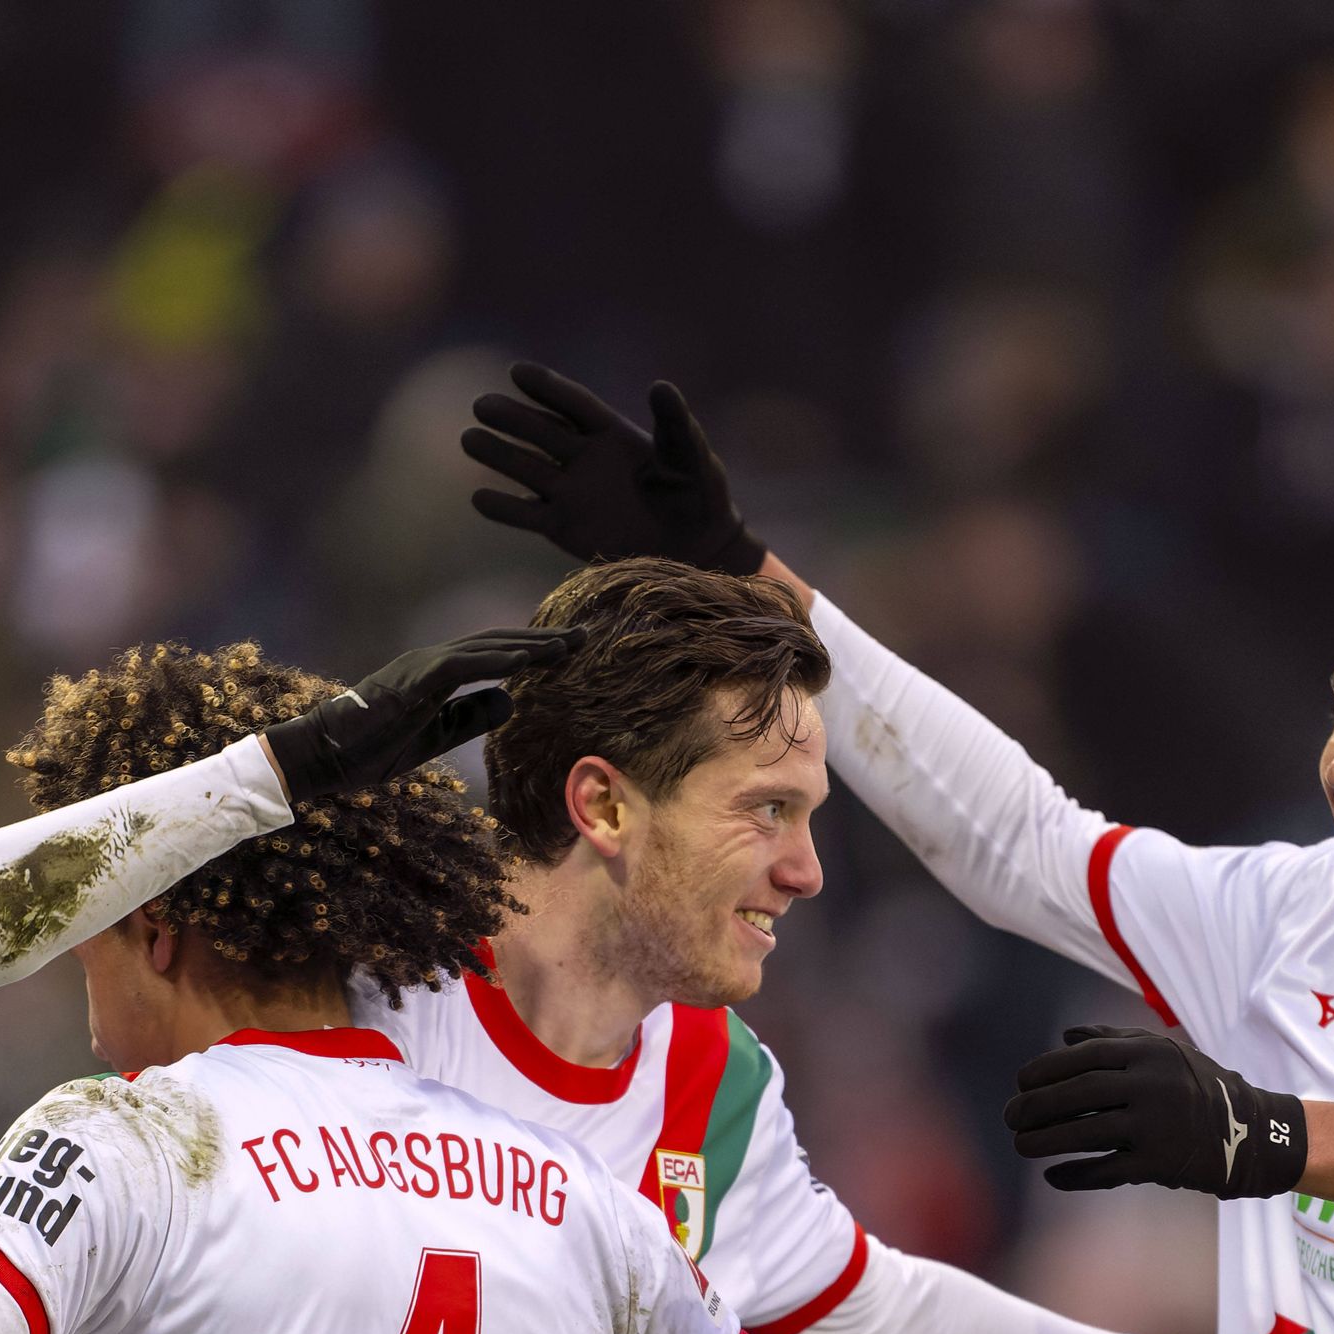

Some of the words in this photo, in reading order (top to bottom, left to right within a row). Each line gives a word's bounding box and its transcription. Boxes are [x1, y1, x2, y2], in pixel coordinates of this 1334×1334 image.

[1269, 1118, 1291, 1147] 25
[241, 1127, 319, 1203] FC
[317, 1126, 568, 1227] AUGSBURG
[663, 1157, 700, 1185] FCA
